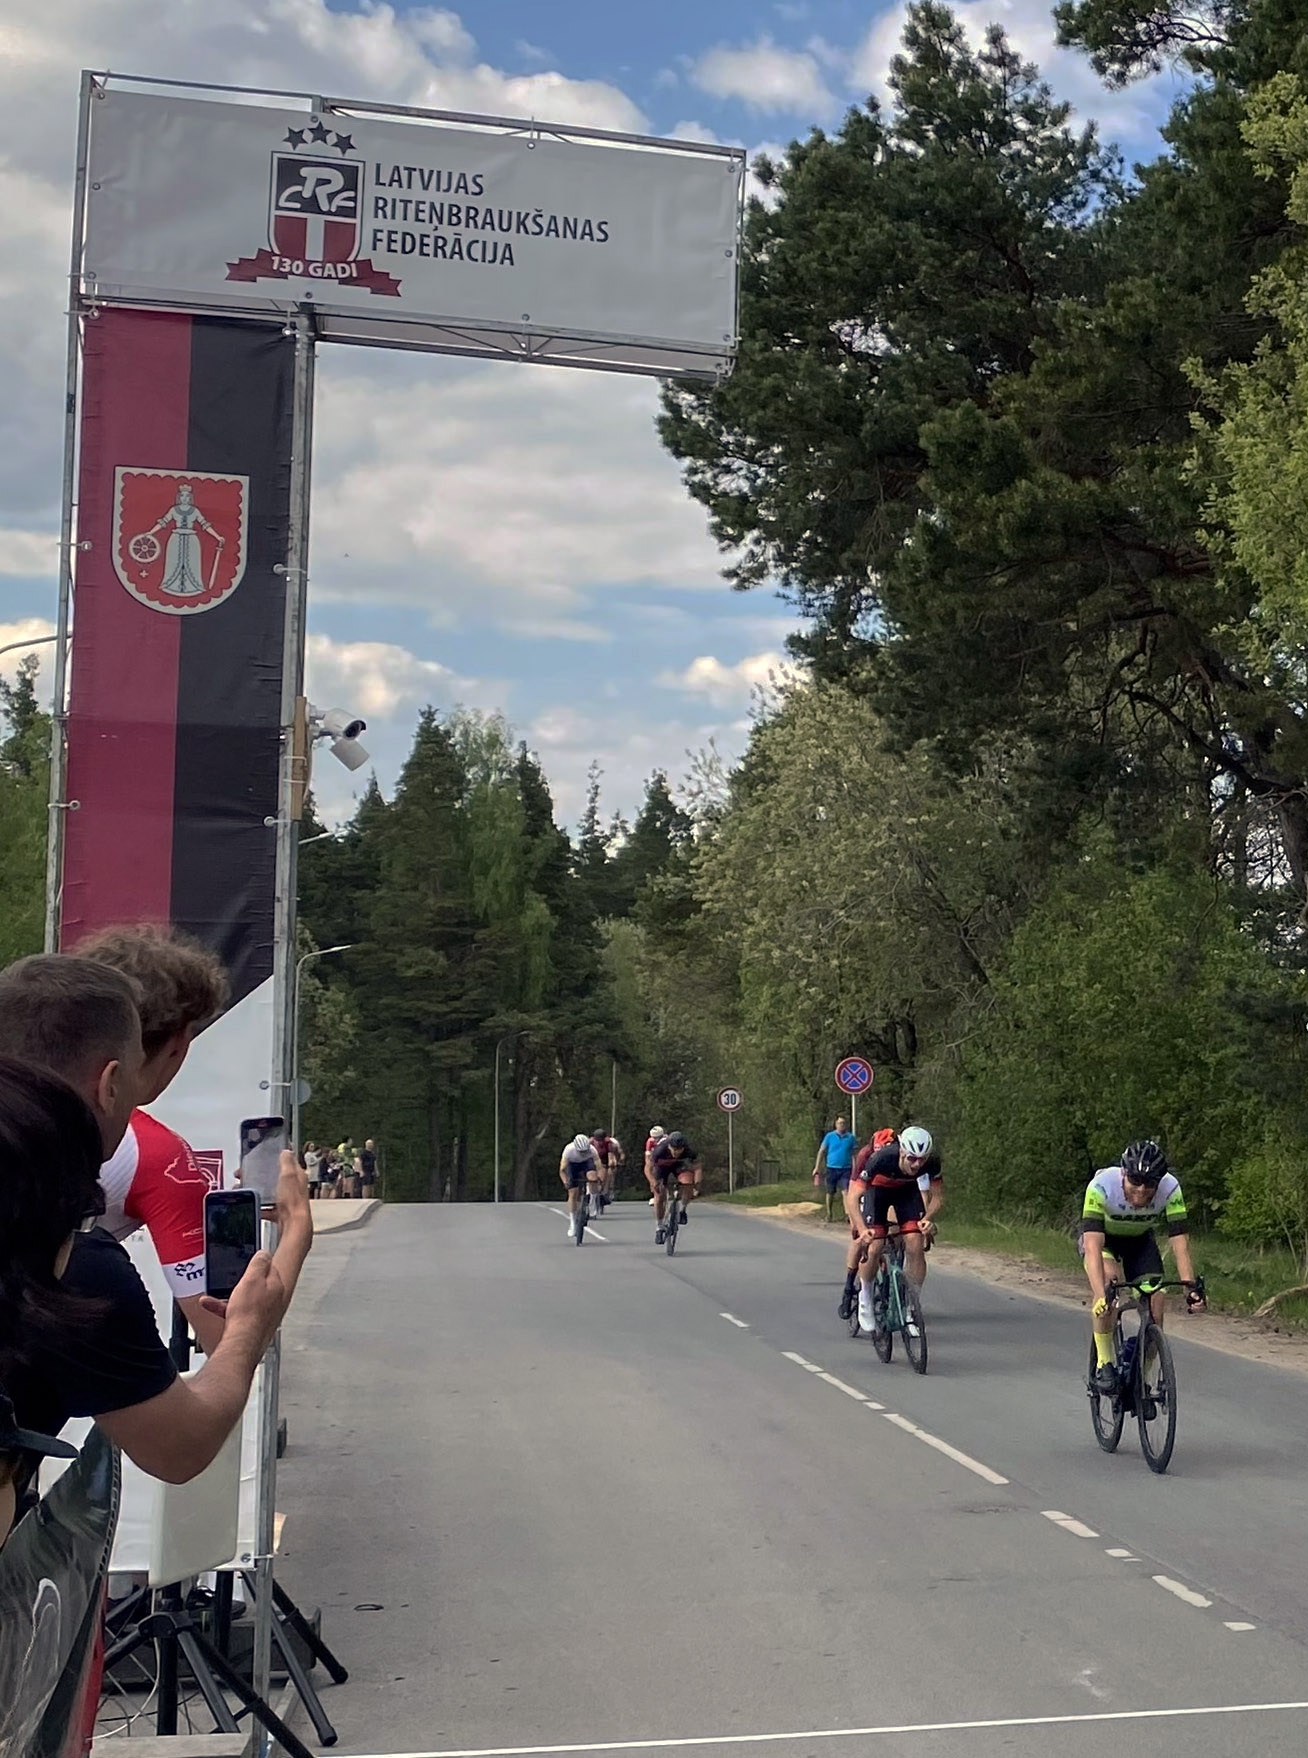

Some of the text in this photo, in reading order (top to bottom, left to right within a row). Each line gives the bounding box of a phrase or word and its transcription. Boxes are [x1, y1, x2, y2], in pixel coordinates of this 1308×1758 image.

[374, 162, 484, 197] LATVIJAS
[373, 196, 610, 243] RITEŅBRAUKŠANAS
[371, 228, 515, 266] FEDERĀCIJA
[271, 256, 358, 279] 130 GADI
[724, 1093, 737, 1105] 30
